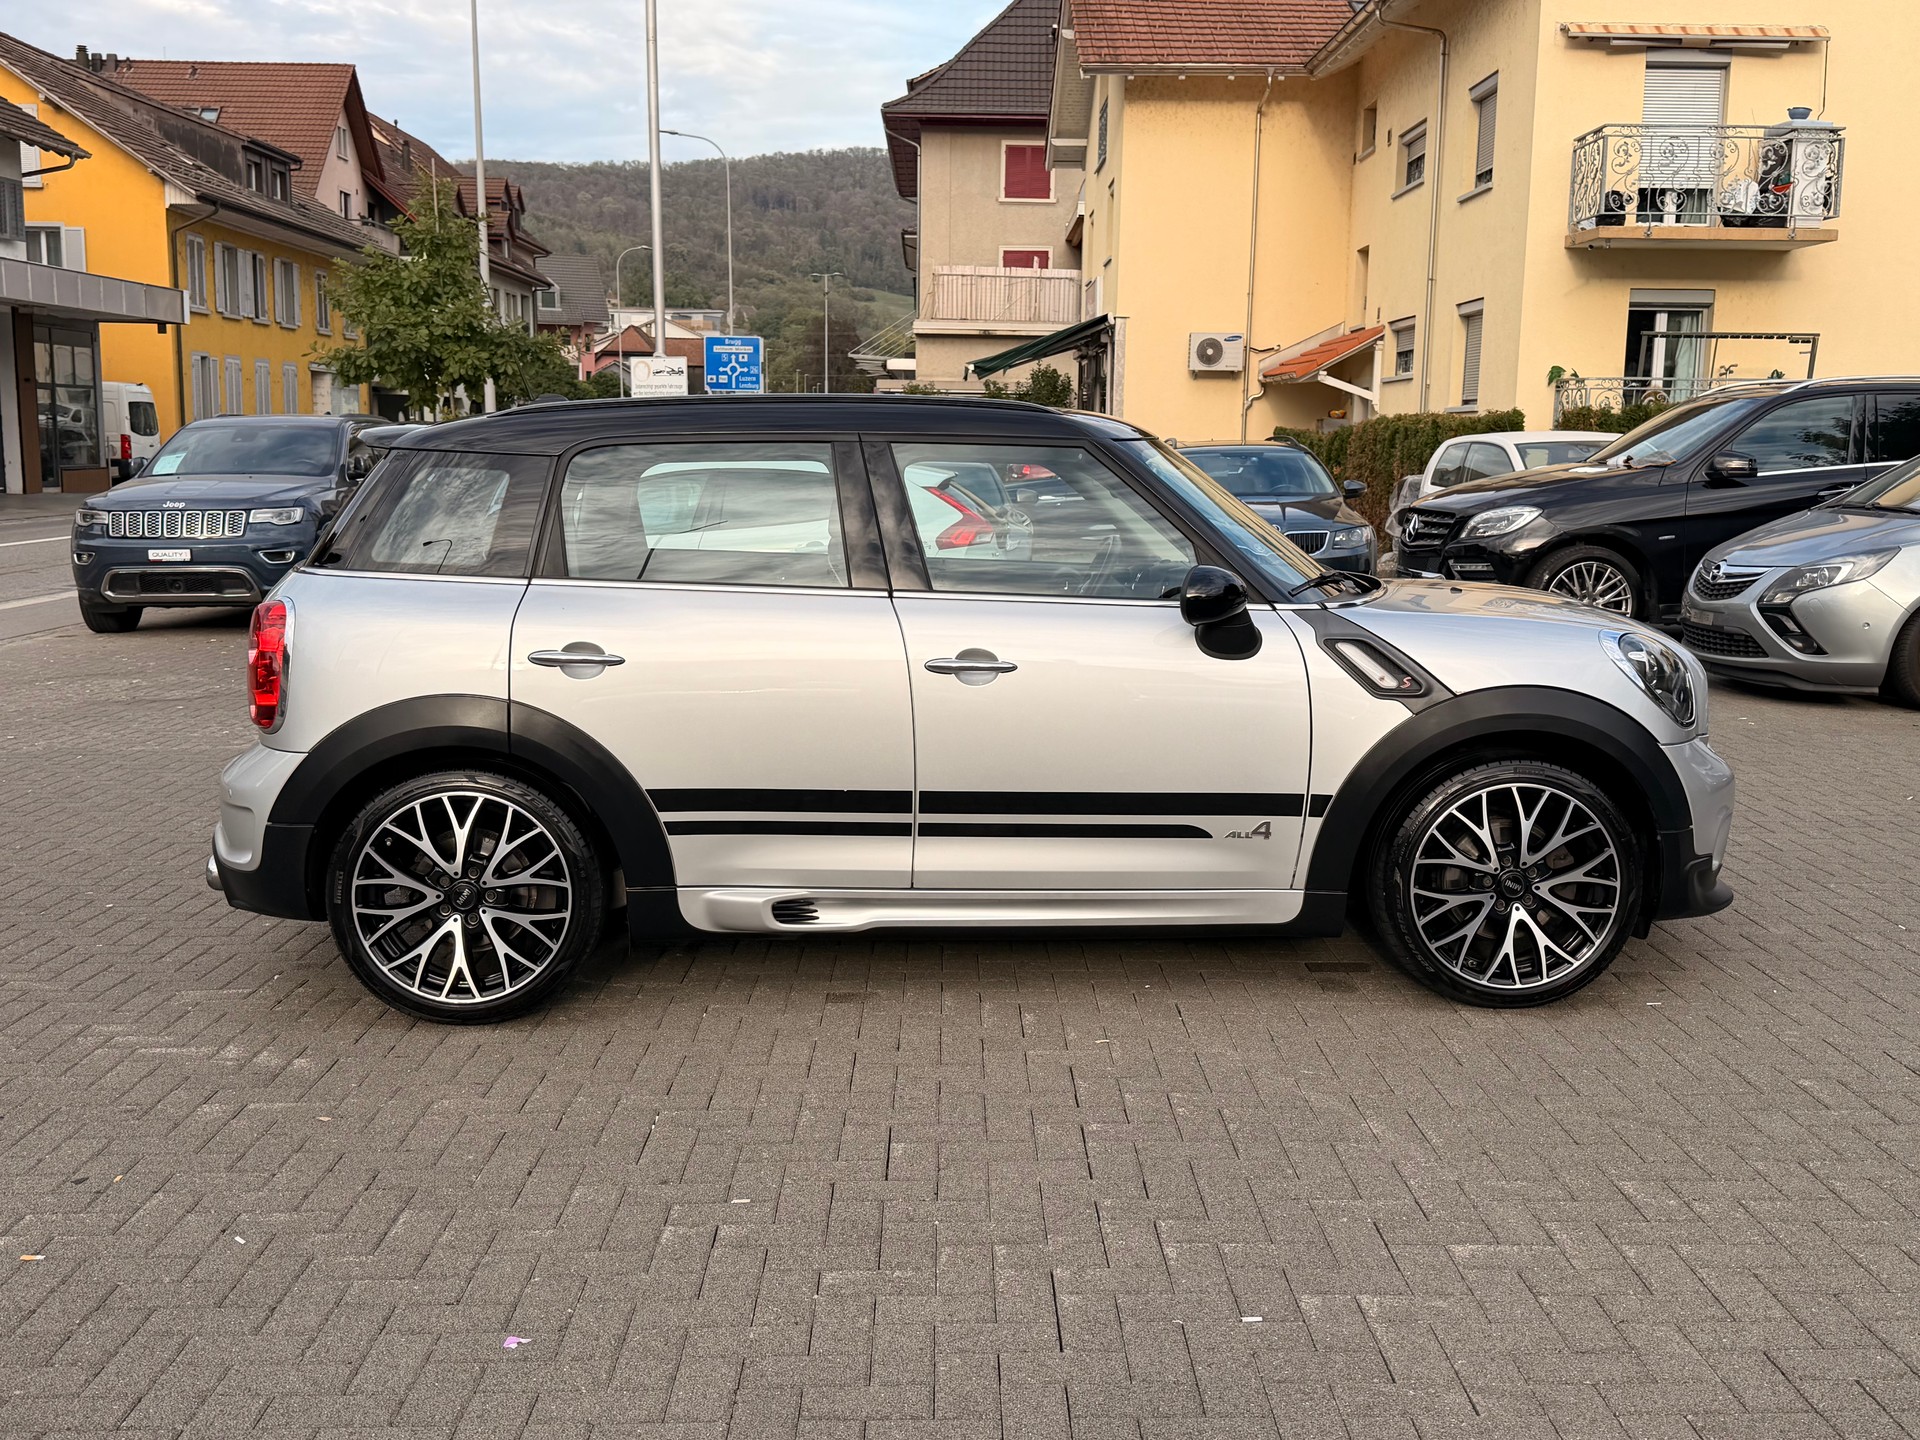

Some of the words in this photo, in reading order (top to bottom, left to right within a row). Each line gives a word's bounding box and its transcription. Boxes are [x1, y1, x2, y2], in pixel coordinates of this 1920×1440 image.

[162, 501, 186, 509] Jeep
[1399, 676, 1412, 688] S
[1223, 820, 1272, 840] ALL4
[1504, 879, 1522, 891] MINI
[456, 888, 472, 905] MINI
